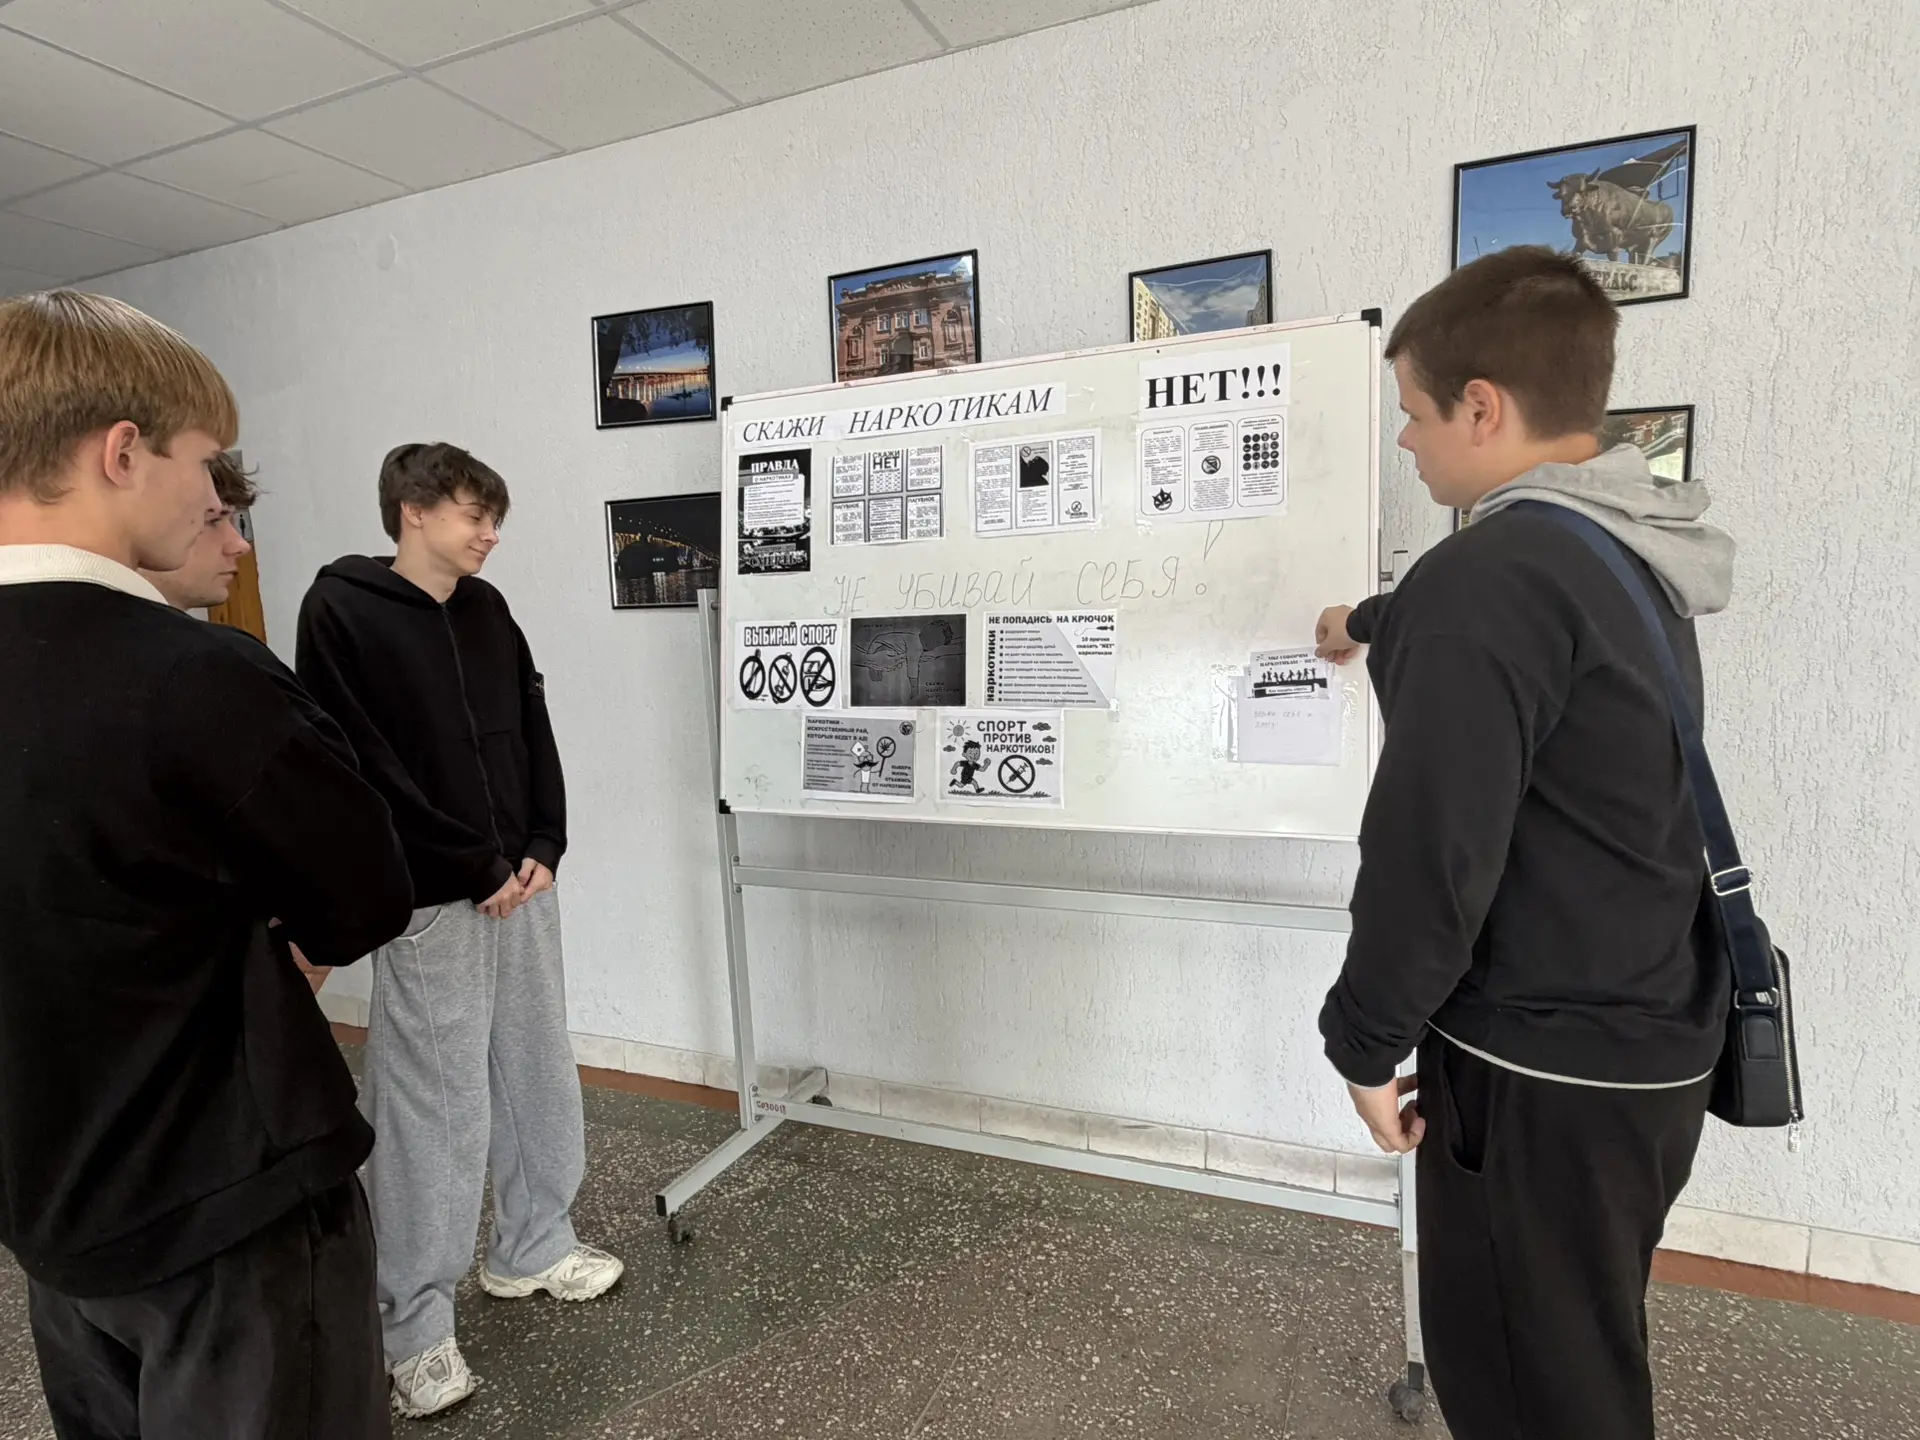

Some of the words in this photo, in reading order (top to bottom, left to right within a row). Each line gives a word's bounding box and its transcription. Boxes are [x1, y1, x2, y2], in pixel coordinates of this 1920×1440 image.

[1145, 363, 1281, 409] НЕТ!!!
[743, 415, 826, 442] СКАЖИ
[848, 387, 1054, 434] НАРКОТИКАМ
[872, 450, 900, 458] СКАЖИ
[751, 458, 800, 474] ПРАВДА
[872, 457, 900, 469] НЕТ
[895, 557, 1034, 610] УБИВАЙ
[988, 616, 1000, 624] НЕ
[1003, 615, 1052, 625] ПОПАДИСЬ
[1072, 615, 1114, 623] КРЮЧОК
[744, 622, 798, 647] ВЫБИРАЙ
[800, 624, 837, 646] СПОРТ
[987, 629, 997, 702] наркотики
[977, 720, 1027, 732] СПОРТ
[983, 733, 1032, 743] ПРОТИВ
[986, 744, 1055, 754] НАРКОТИКОВ!
